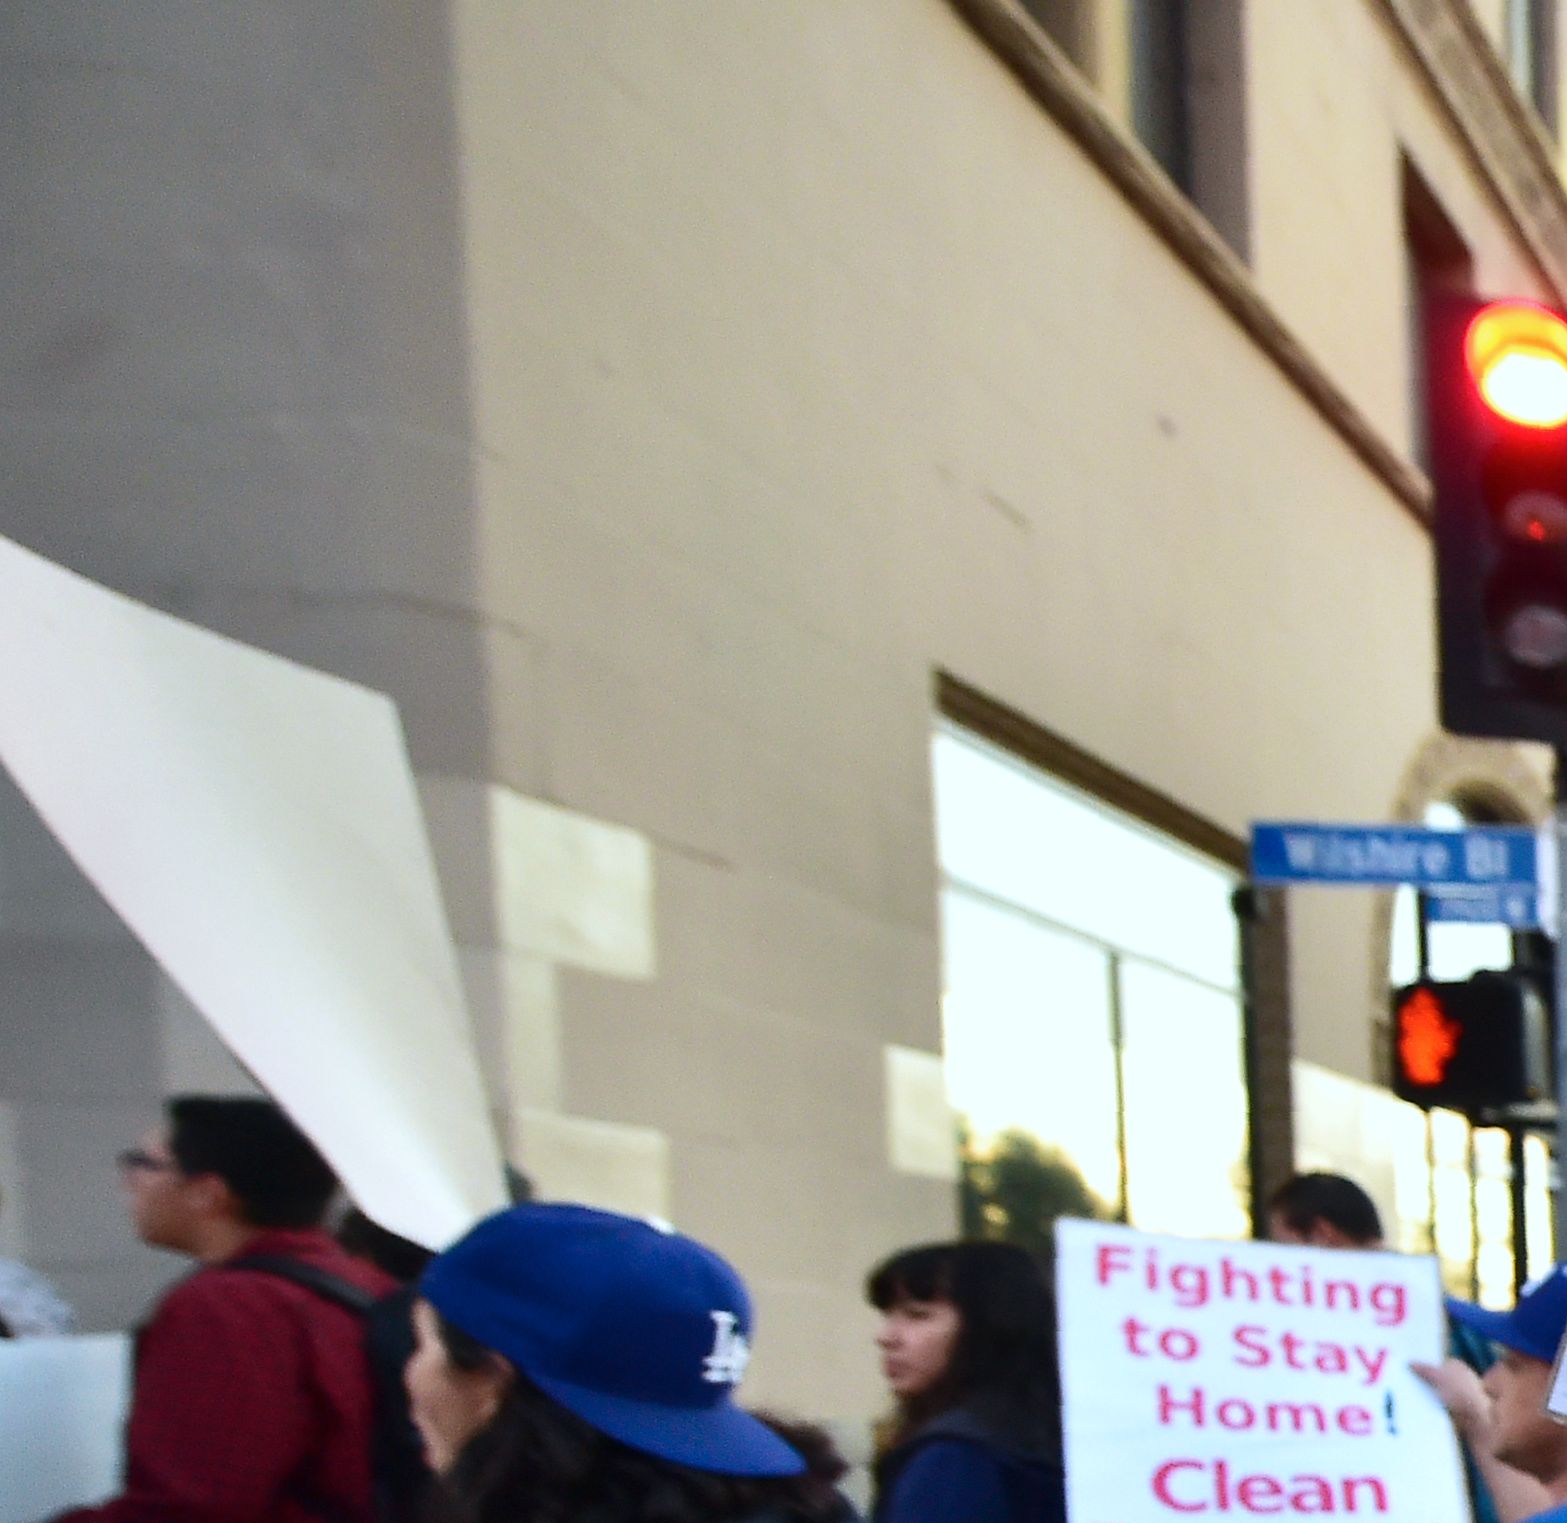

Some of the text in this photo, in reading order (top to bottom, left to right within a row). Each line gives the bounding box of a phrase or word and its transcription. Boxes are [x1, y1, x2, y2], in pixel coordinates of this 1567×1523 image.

[1283, 833, 1451, 876] Wilshire
[1095, 1243, 1409, 1328] Fighting
[1122, 1316, 1389, 1385] to Stay
[1156, 1384, 1401, 1436] Home!
[1150, 1458, 1390, 1515] Clean
